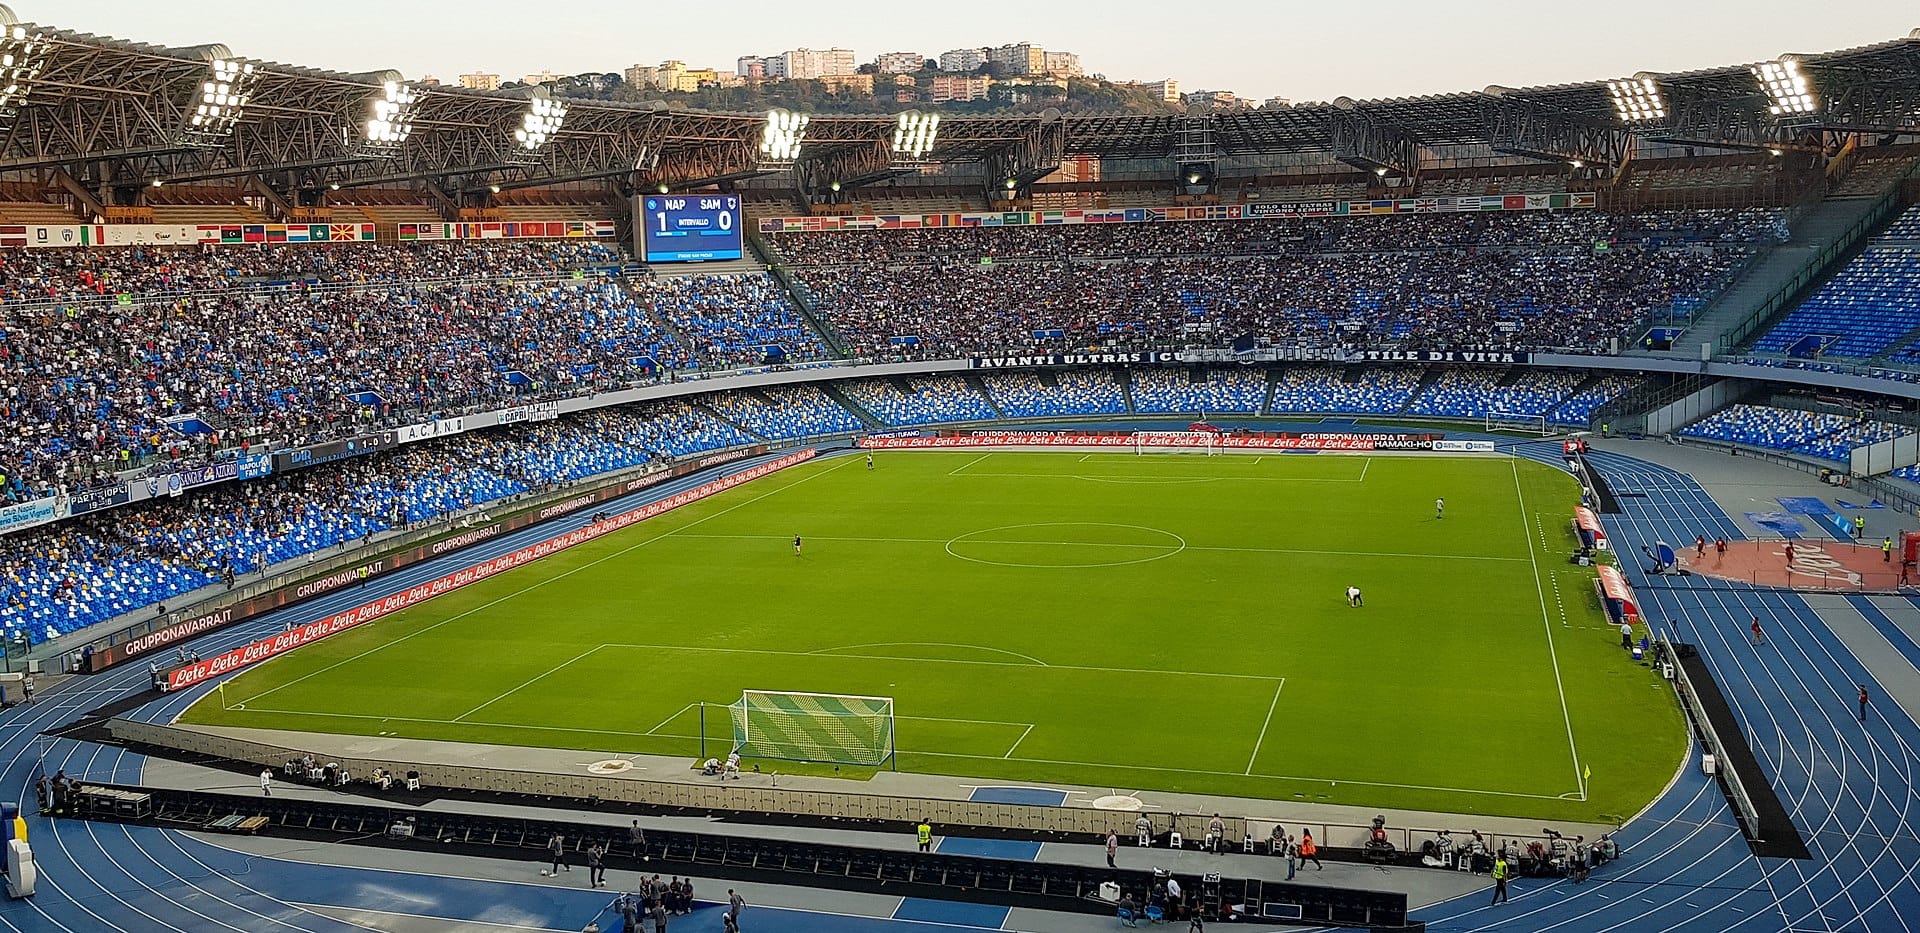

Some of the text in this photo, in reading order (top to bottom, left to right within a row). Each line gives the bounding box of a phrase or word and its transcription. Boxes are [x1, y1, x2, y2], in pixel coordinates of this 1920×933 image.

[665, 199, 720, 210] NAP SAM
[656, 210, 732, 231] 1 INTERVALLO 0
[980, 356, 1054, 368] AVANTI
[1064, 353, 1140, 364] ULTRAS
[1429, 352, 1454, 361] DI
[1462, 352, 1514, 363] VITA
[528, 401, 558, 412] APULIA
[504, 410, 526, 422] CAPRI
[861, 440, 882, 448] Lete
[884, 439, 908, 448] Lete
[909, 438, 932, 447] Lete
[931, 438, 955, 446] Lete
[956, 437, 978, 446] Lete
[980, 436, 1003, 445] Lete
[1004, 436, 1026, 444] Lete
[1027, 436, 1050, 444] Lete
[1050, 436, 1074, 444] Lete
[1074, 436, 1096, 444] Lete
[1098, 436, 1120, 445] Lete
[1147, 436, 1172, 446] Lete
[1172, 436, 1196, 446] Lete
[1220, 437, 1244, 446] Lete
[1246, 438, 1270, 447] Lete
[1270, 438, 1294, 448] Lete
[1297, 439, 1320, 448] Lete
[1321, 439, 1348, 448] Lete
[1348, 440, 1374, 449] Lete
[1374, 440, 1432, 448] HAMAKI-HO
[700, 449, 750, 467] GRUPPONAVARRA.IT
[240, 462, 261, 471] NAPOLI
[246, 470, 258, 478] FAN
[180, 470, 203, 486] SANGUE
[628, 470, 672, 490] GRUPPONAVARRA.IT
[540, 494, 596, 519] GRUPPONAVARRA.IT
[432, 524, 500, 554] GRUPPONAVARRA.IT
[296, 561, 383, 598] GRUPPONAVAA.IT
[172, 666, 204, 688] Lete
[207, 654, 238, 676] Lete
[240, 642, 270, 664] Lete
[272, 630, 300, 652] Lete
[301, 620, 328, 640] Lete
[329, 612, 354, 630] Lete
[356, 604, 380, 622] Lete
[382, 594, 406, 612] Lete
[406, 586, 428, 604] Lete
[430, 578, 451, 595] Lete
[452, 570, 473, 586] Lete
[474, 562, 494, 579] Lete
[494, 556, 514, 572] Lete
[514, 550, 532, 564] Lete
[532, 542, 551, 558] Lete
[550, 536, 568, 551] Lete
[568, 530, 586, 546] Lete
[585, 524, 601, 538] Lete
[600, 518, 616, 533] Lete
[617, 514, 632, 526] Lete
[125, 609, 232, 655] GRUPPONAVARRA.IT
